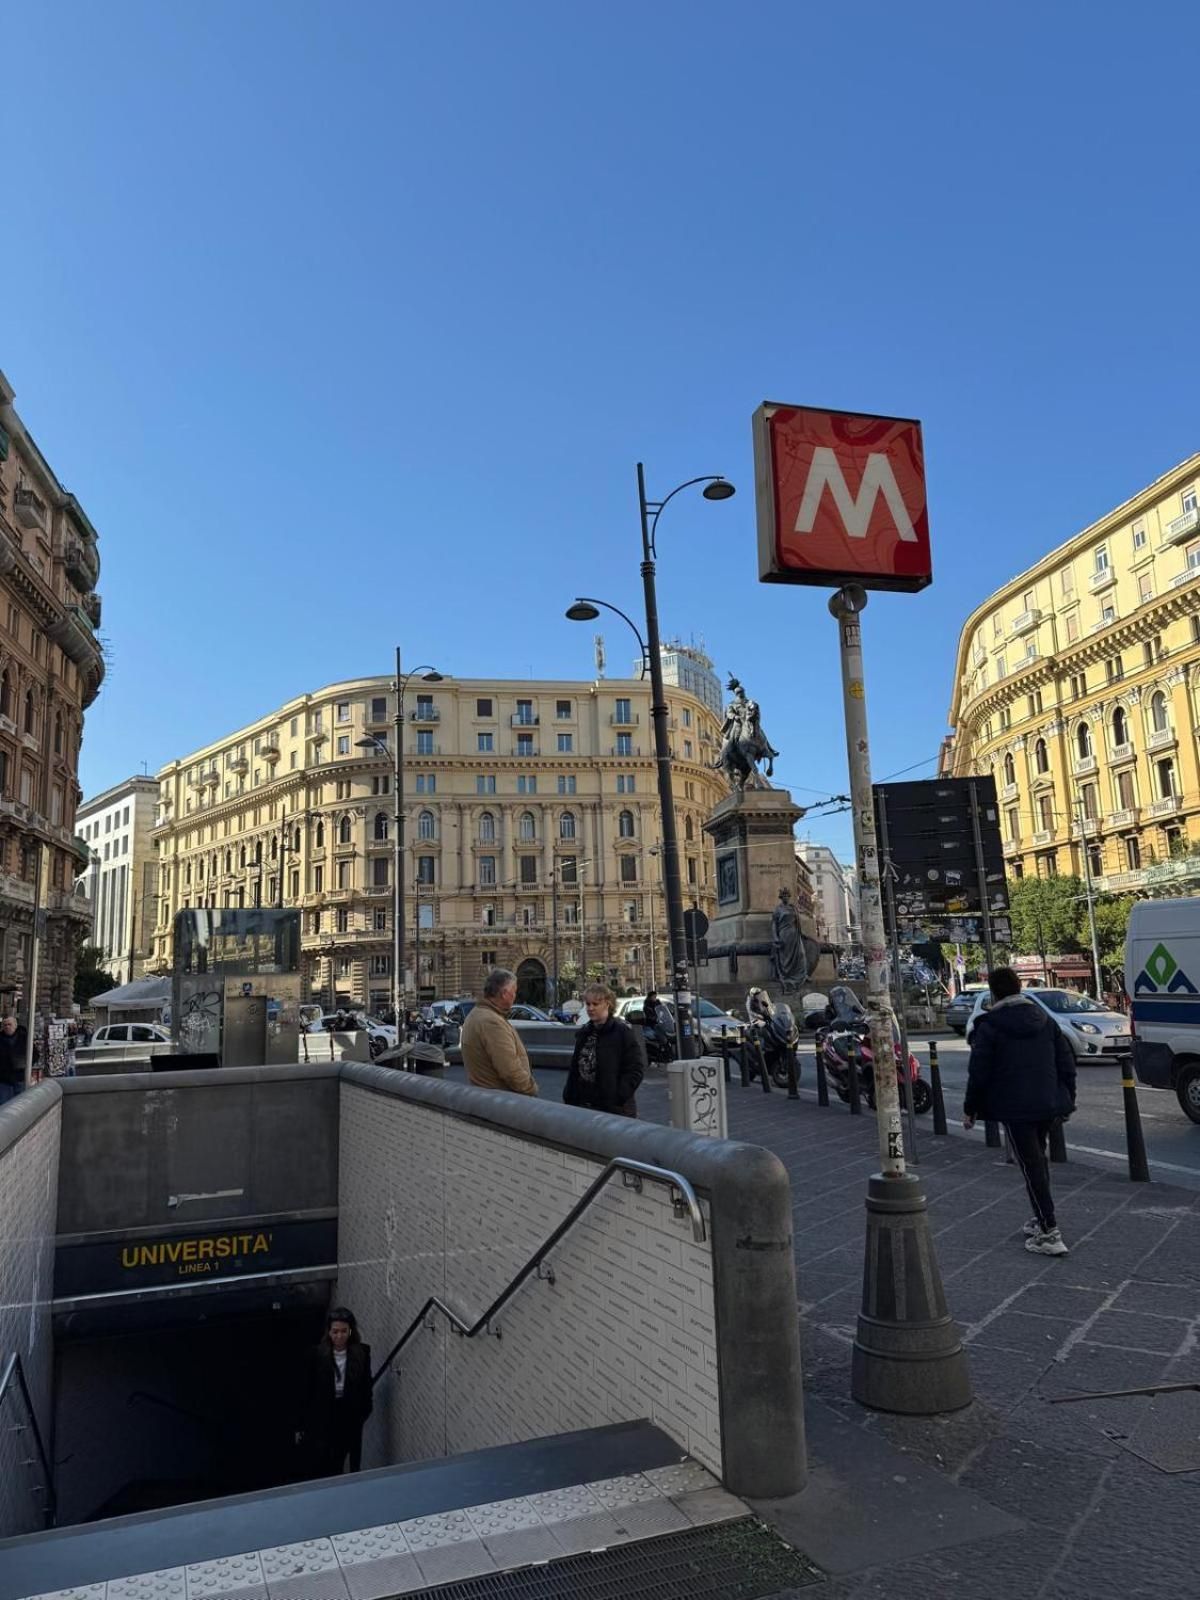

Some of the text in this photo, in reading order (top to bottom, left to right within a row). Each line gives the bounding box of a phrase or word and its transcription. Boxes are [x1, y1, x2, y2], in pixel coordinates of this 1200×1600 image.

[794, 446, 919, 543] M
[121, 1233, 273, 1268] UNIVERSITA'
[178, 1262, 211, 1275] LINEA
